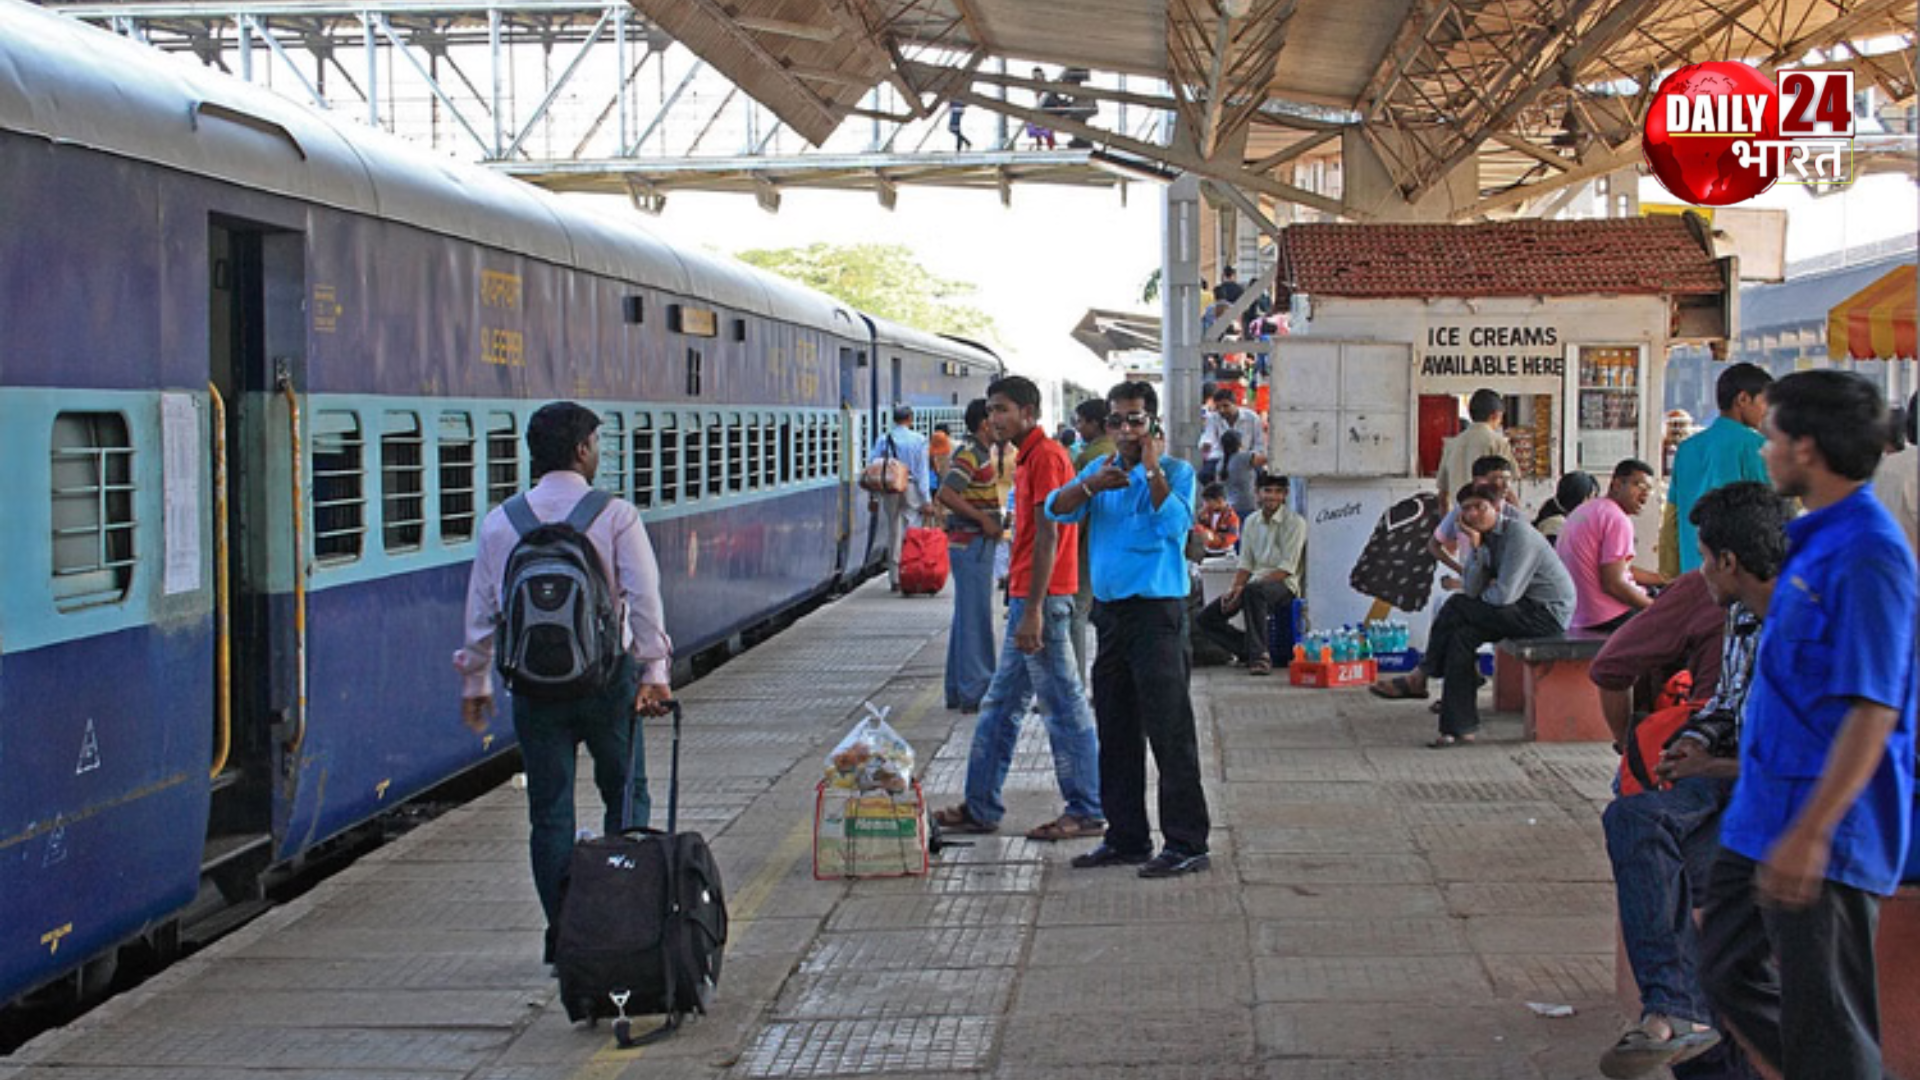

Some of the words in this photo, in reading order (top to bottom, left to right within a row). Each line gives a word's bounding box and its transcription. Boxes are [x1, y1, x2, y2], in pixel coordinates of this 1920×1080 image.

[1428, 327, 1460, 346] ICE
[1469, 327, 1557, 346] CREAMS
[1421, 355, 1518, 376] AVAILABLE
[1523, 357, 1564, 376] HERE
